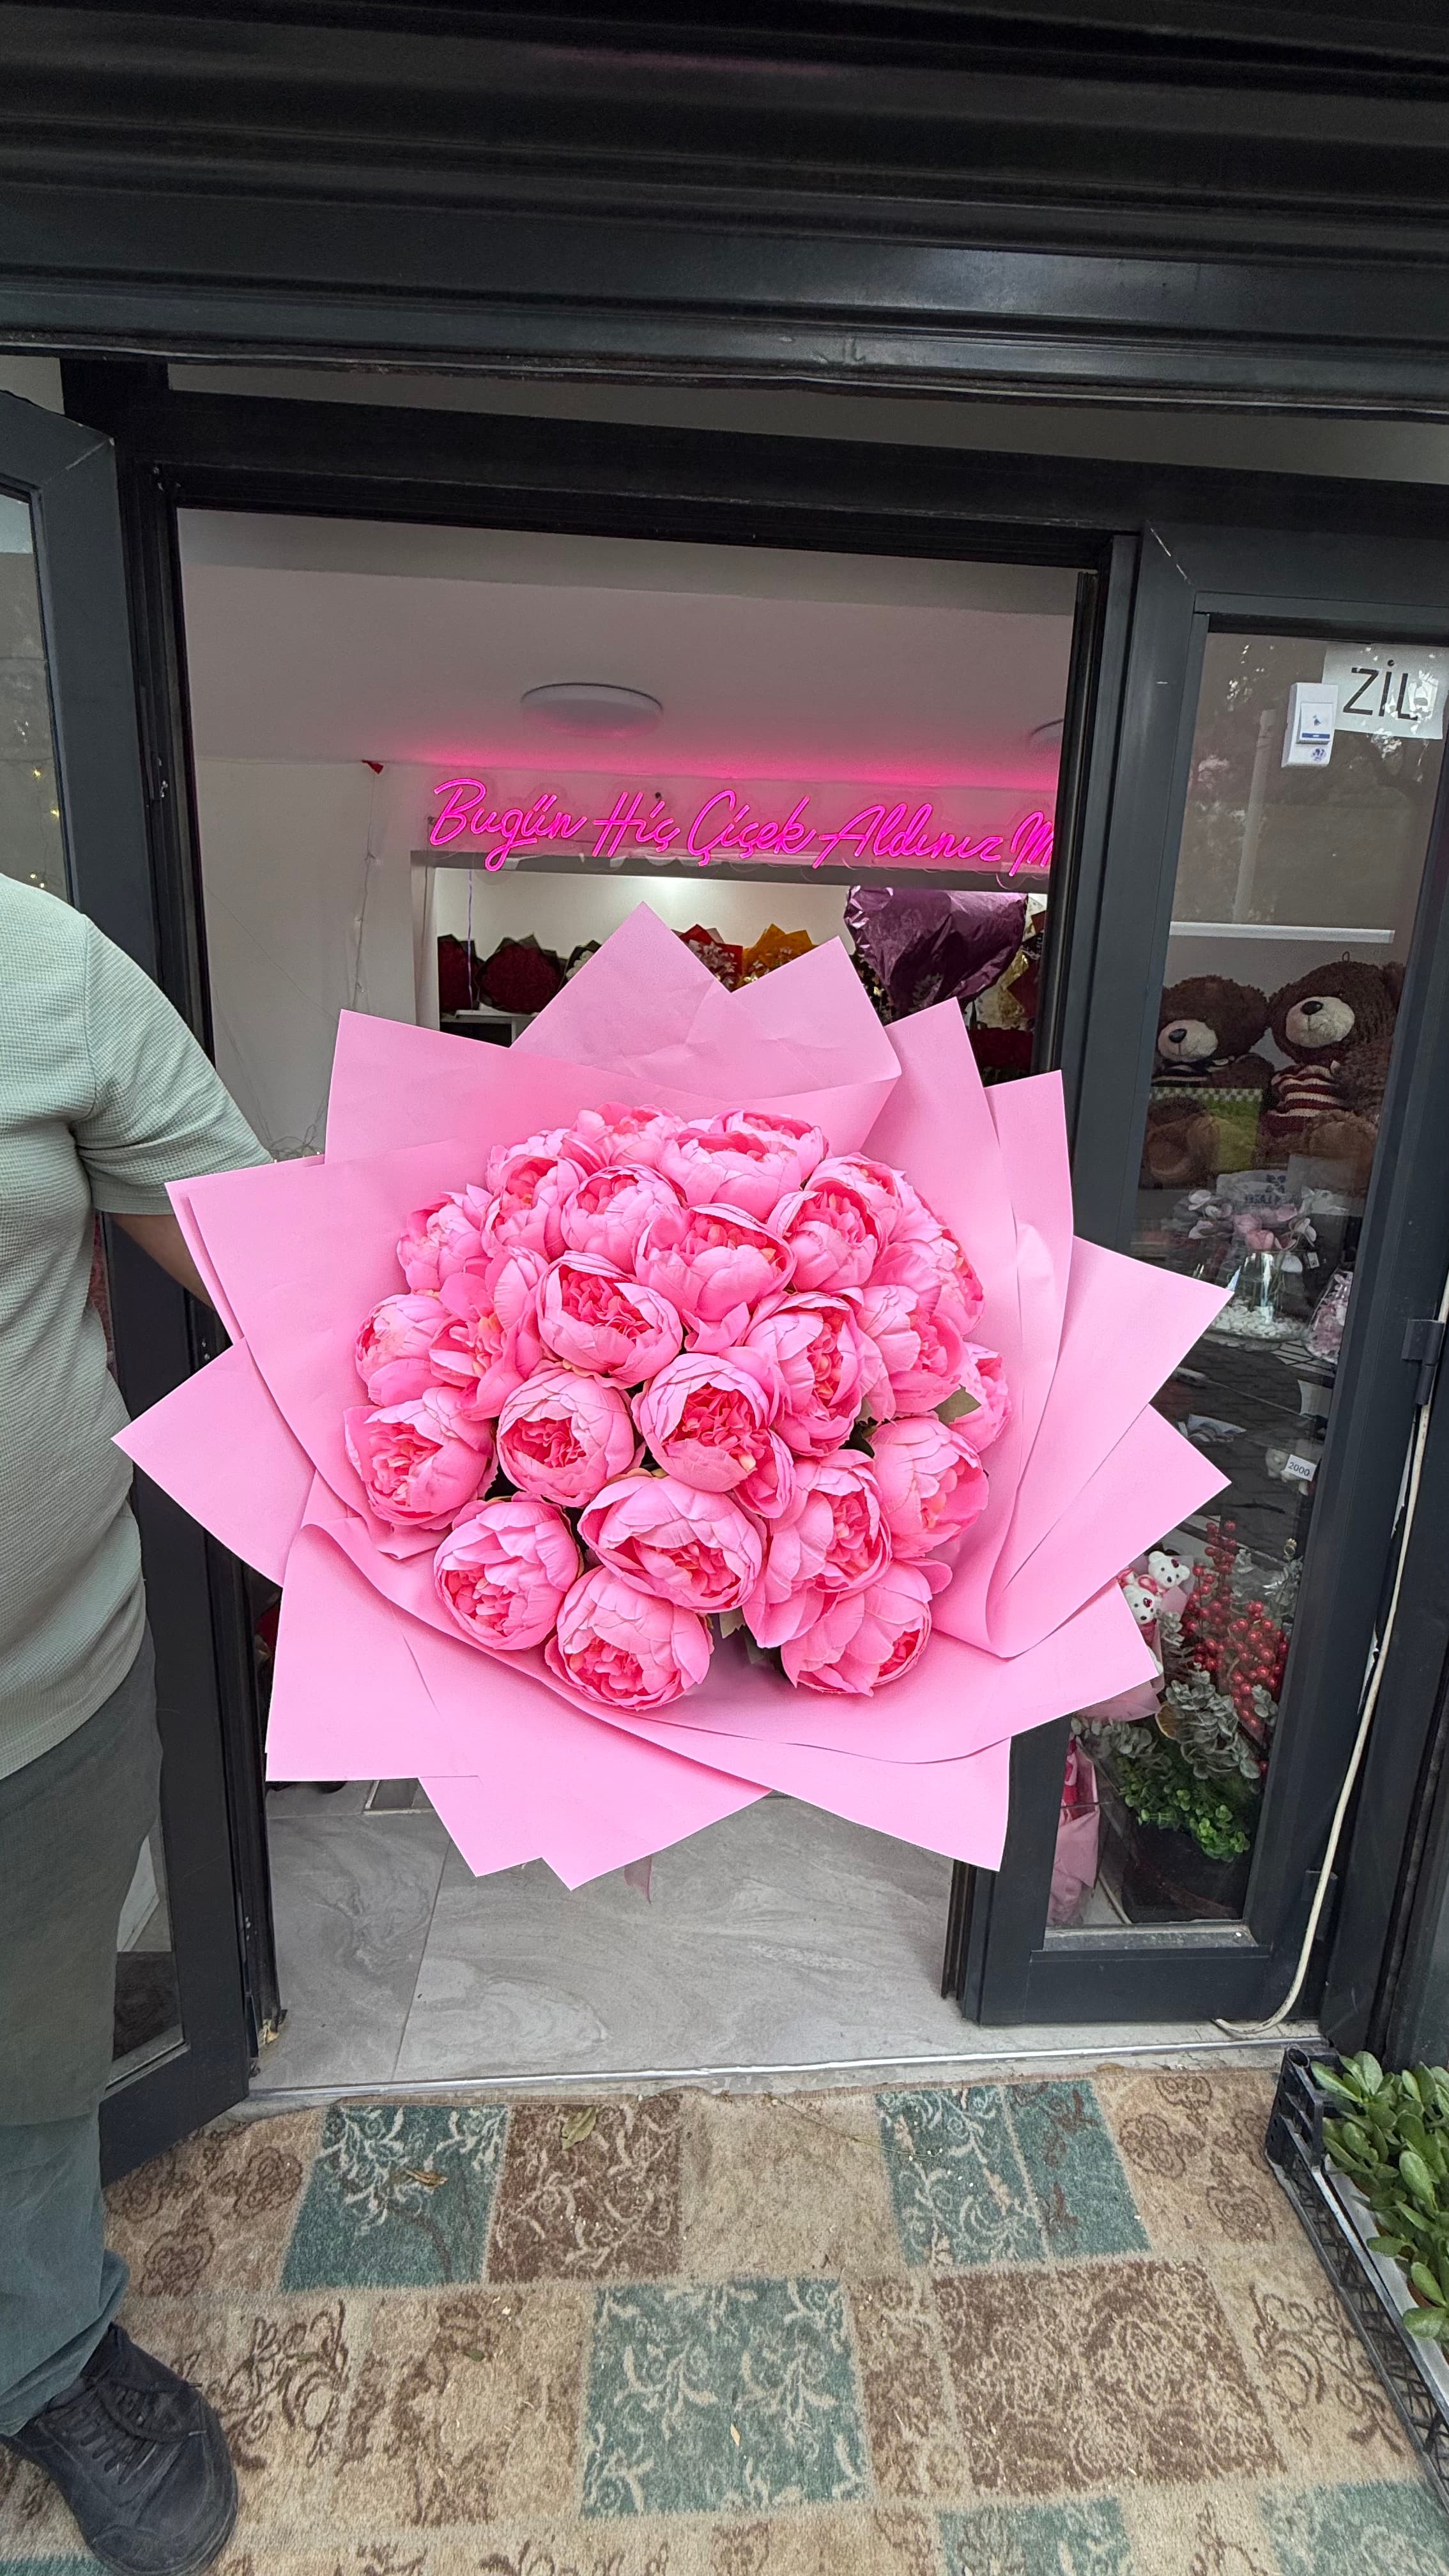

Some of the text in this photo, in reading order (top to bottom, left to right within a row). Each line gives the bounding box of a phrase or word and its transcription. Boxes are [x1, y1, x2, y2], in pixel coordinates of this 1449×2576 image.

[1342, 659, 1418, 721] ZİL
[429, 777, 588, 872] Bugün
[592, 791, 680, 857] Hiç
[686, 789, 817, 867] Çiçek
[812, 802, 1004, 869] Aldınız
[1287, 1461, 1310, 1476] 2000
